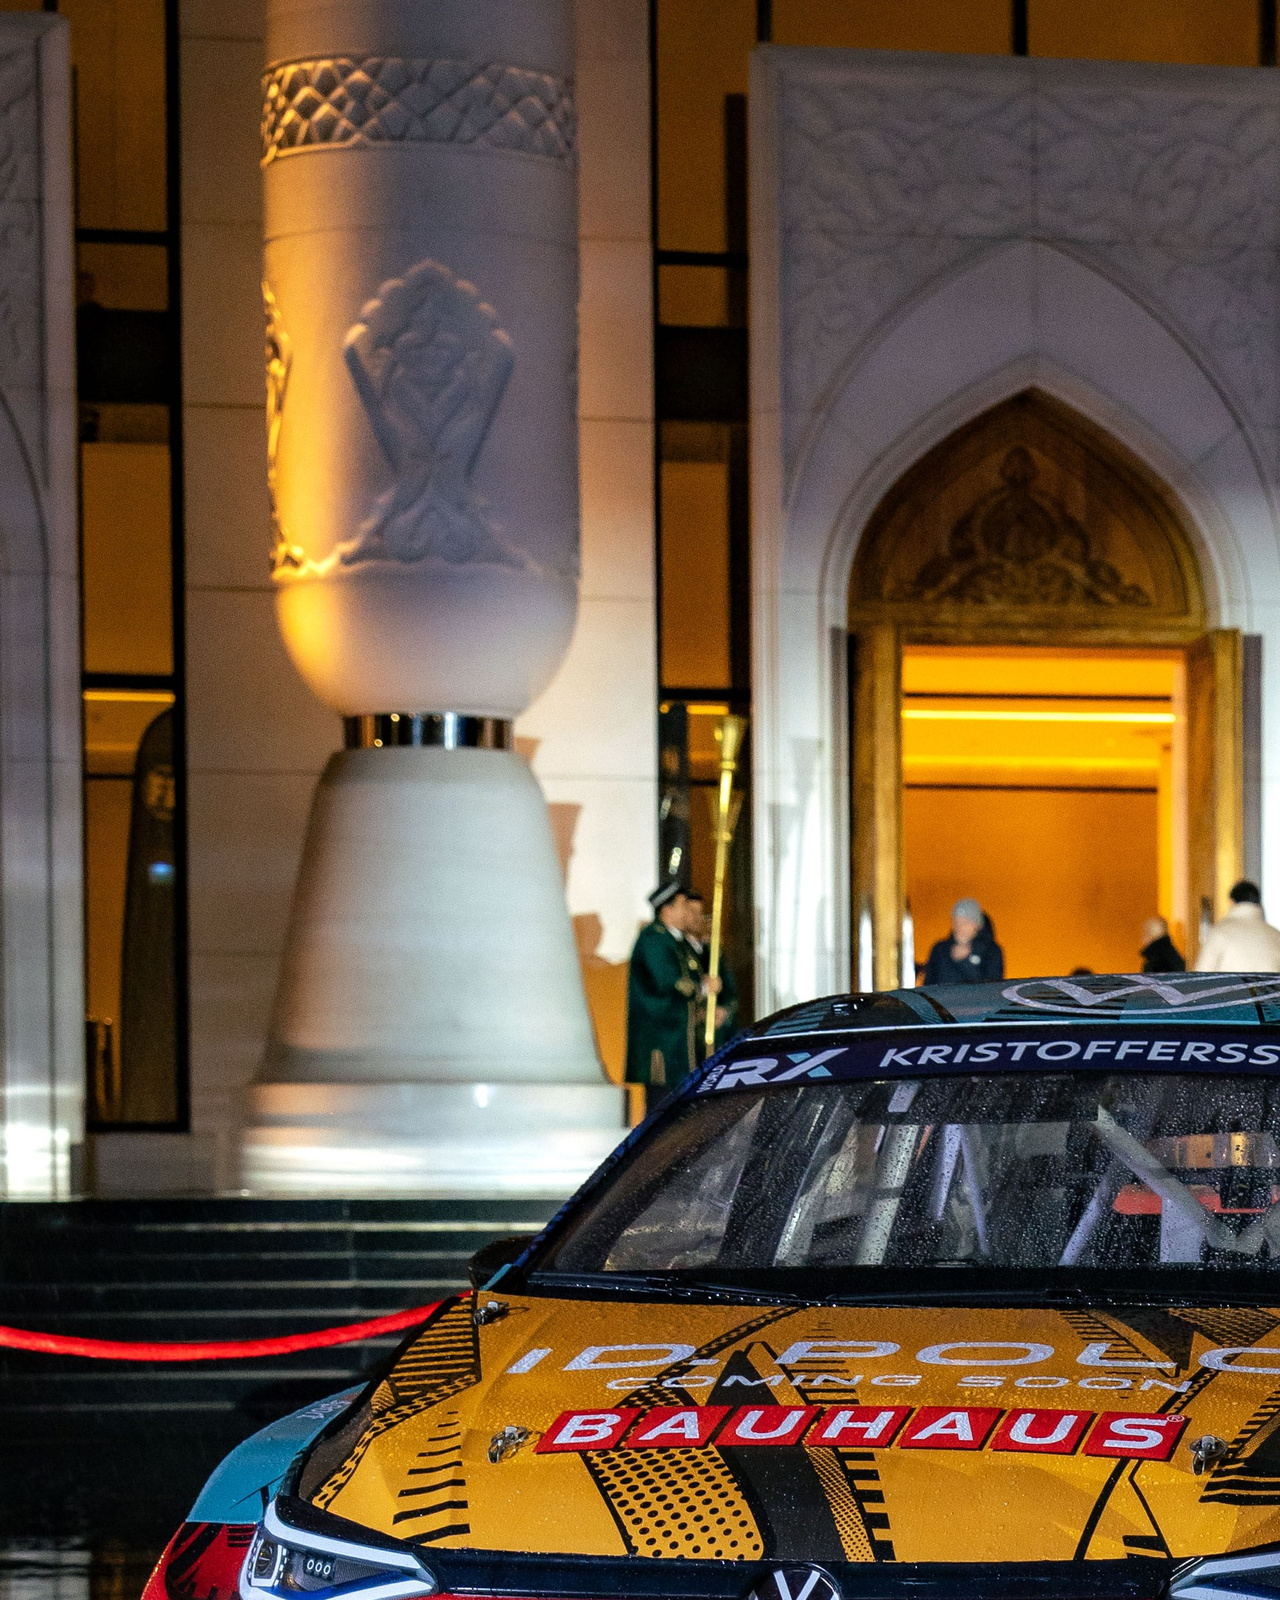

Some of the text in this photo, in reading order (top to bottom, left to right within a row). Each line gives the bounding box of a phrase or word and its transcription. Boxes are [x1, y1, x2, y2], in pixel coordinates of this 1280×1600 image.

[715, 1047, 849, 1090] RX
[605, 1374, 1193, 1394] COMING SOON
